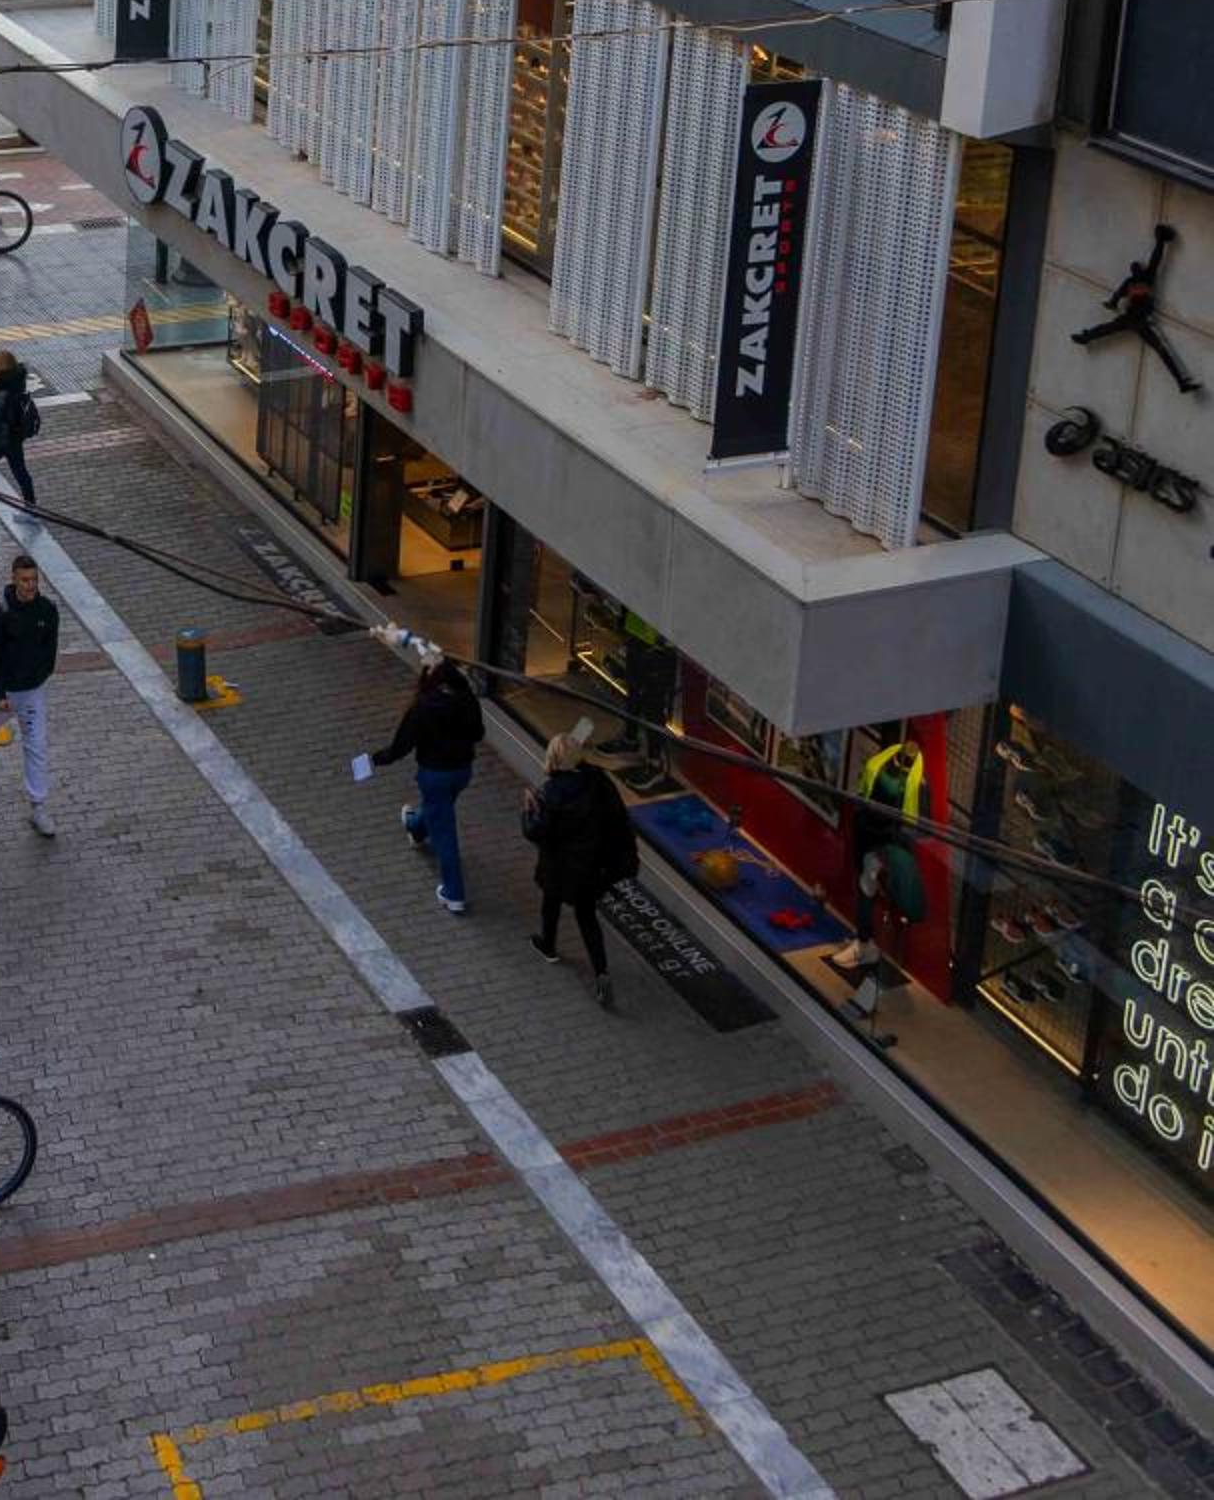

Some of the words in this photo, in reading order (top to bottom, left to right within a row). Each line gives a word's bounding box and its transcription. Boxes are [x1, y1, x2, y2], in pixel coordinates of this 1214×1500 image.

[163, 140, 424, 377] ZAKCRET
[735, 175, 784, 398] ZAKCRET
[1140, 879, 1176, 931] a
[652, 919, 716, 975] ONLINE
[1113, 1063, 1184, 1141] do
